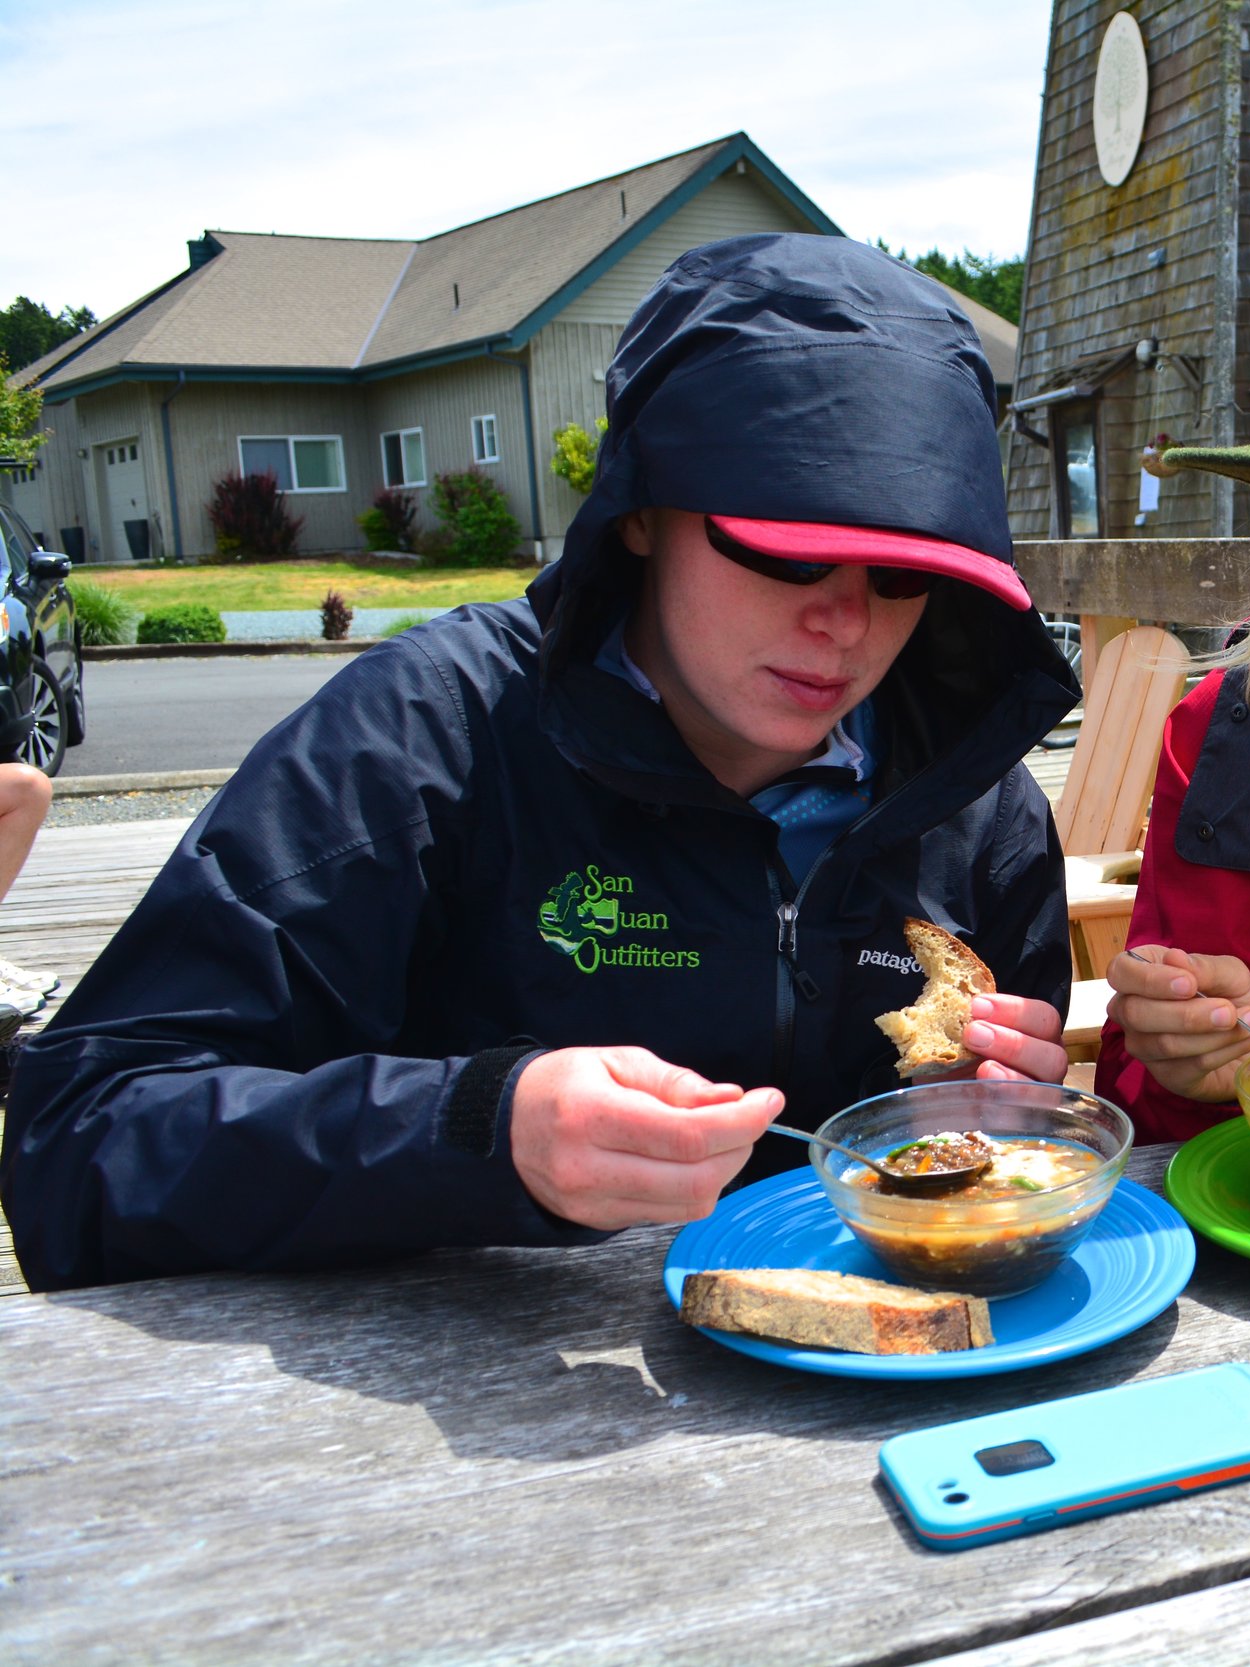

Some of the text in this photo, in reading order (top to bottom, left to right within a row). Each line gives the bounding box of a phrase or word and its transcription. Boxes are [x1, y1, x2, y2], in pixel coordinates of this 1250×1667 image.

[584, 864, 634, 900] San
[574, 936, 701, 974] Outfitters
[857, 949, 925, 975] patago
